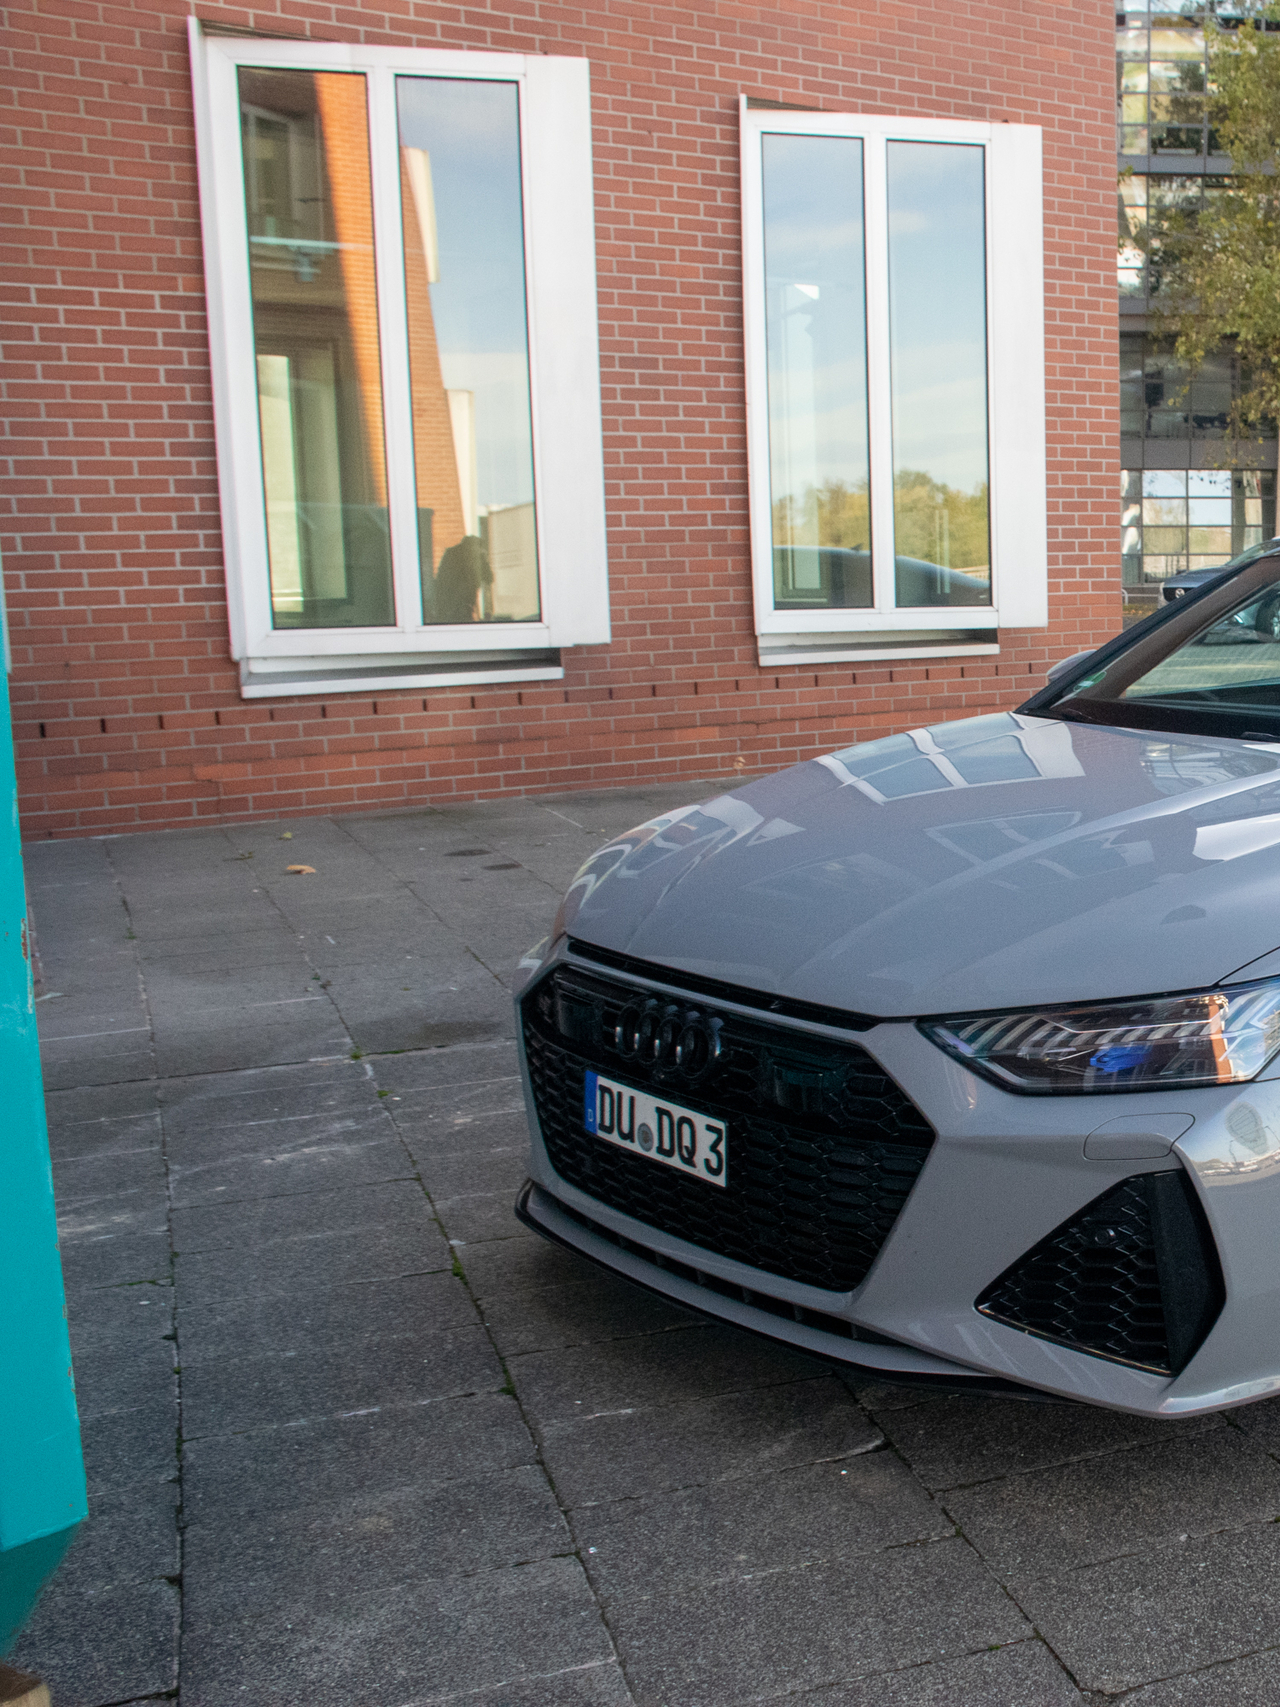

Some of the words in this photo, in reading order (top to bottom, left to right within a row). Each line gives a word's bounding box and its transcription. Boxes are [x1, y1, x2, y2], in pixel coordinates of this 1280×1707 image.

[598, 1084, 636, 1143] DU
[655, 1106, 697, 1168] DQ
[703, 1124, 724, 1176] 3
